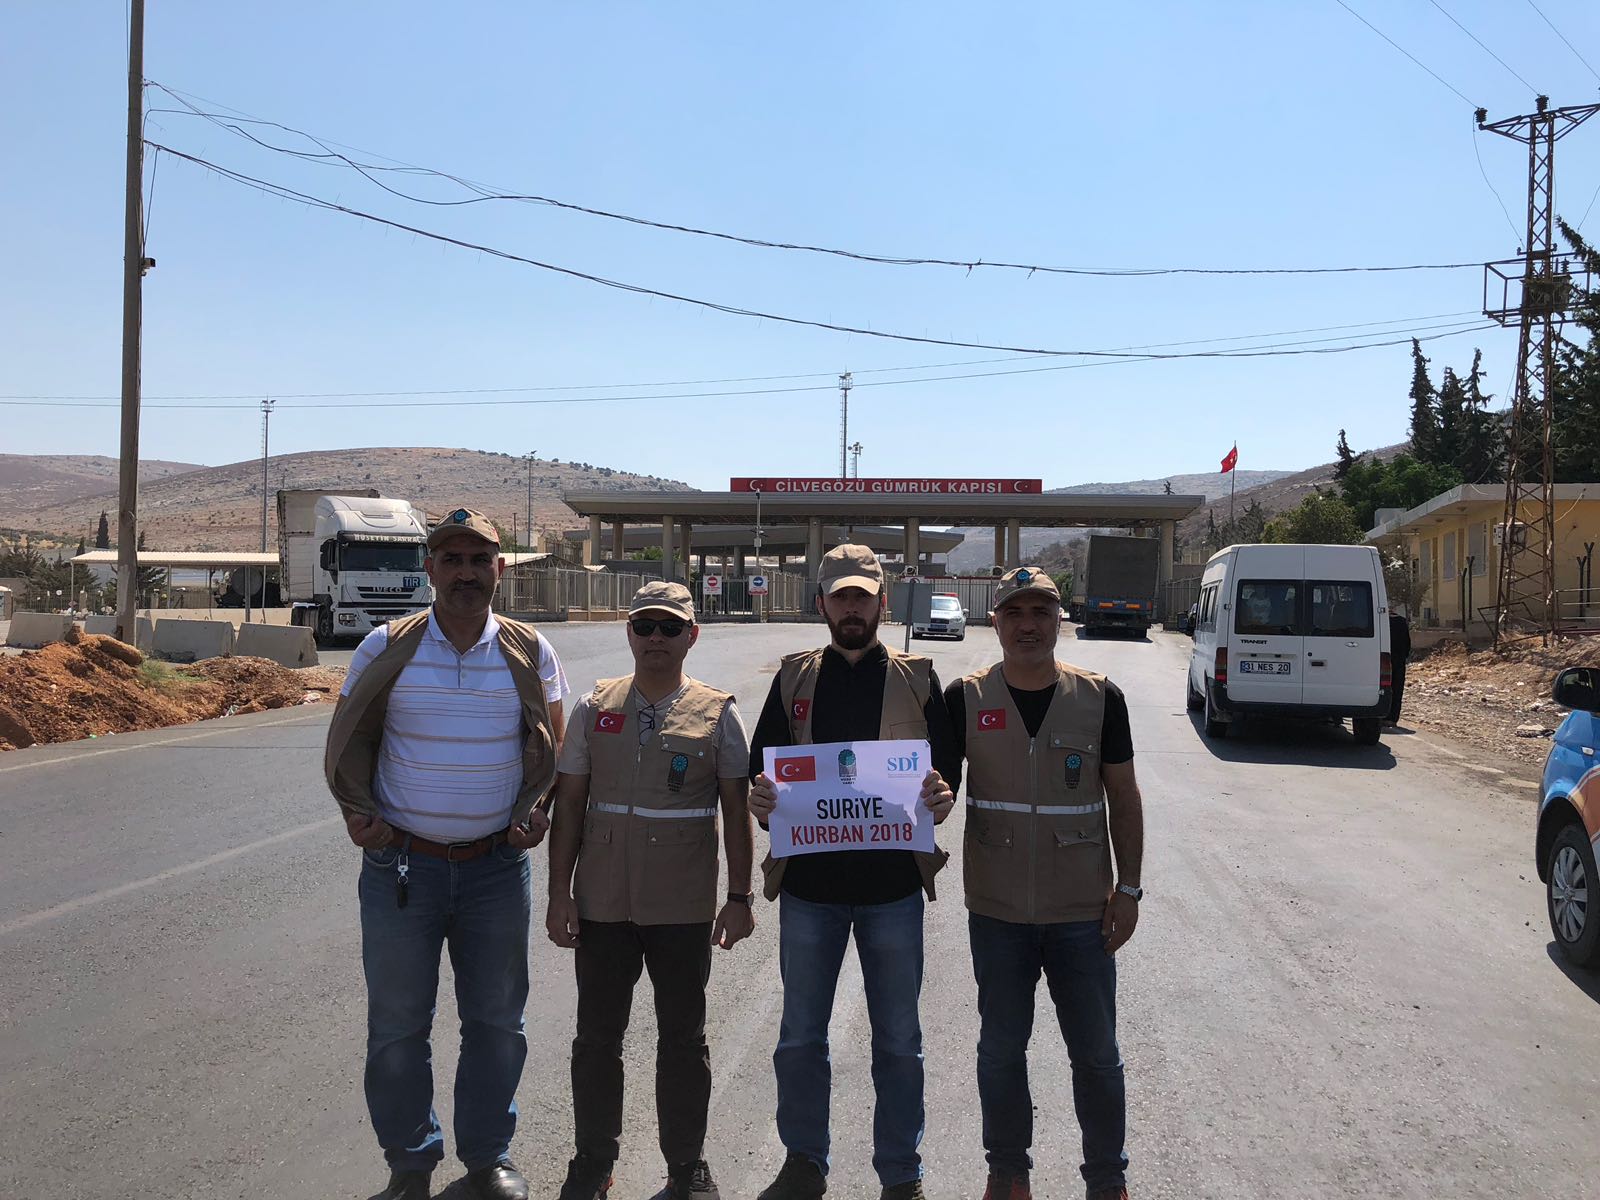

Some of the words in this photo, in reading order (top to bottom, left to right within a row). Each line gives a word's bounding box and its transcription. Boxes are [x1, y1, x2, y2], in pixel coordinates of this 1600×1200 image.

[775, 477, 865, 493] CİLVEGÖZÜ
[871, 479, 942, 493] GÜMRÜK
[947, 481, 1002, 493] KAPISI
[404, 577, 419, 587] TIR
[1246, 662, 1254, 671] 31
[1257, 663, 1274, 671] NES
[1278, 664, 1289, 672] 20
[791, 824, 864, 846] KURBAN
[870, 822, 913, 842] 2018
